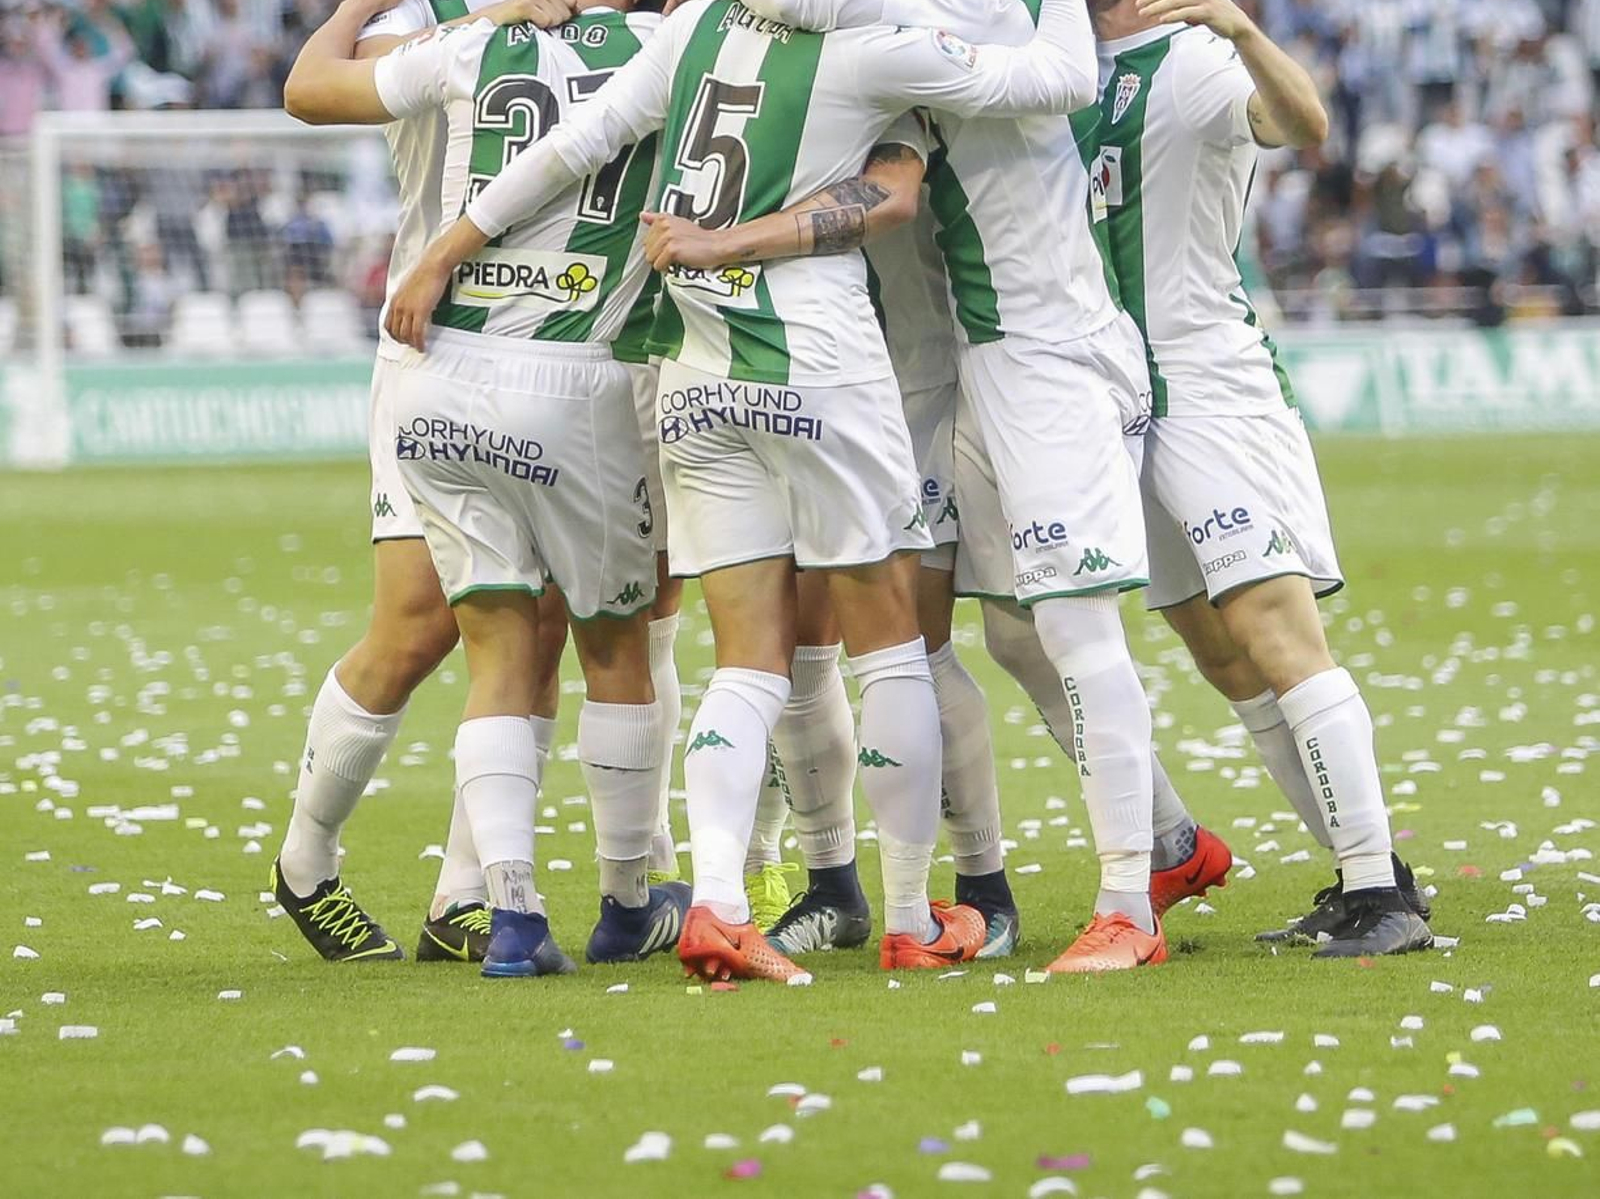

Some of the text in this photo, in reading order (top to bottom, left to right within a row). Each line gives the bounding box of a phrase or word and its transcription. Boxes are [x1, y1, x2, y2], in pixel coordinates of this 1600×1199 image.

[660, 73, 765, 232] 5
[660, 383, 802, 415] CORHYUND
[689, 407, 823, 441] HYUNDAI
[429, 441, 559, 487] HYUNDAI
[1064, 677, 1092, 777] CORDOBA
[1306, 737, 1341, 828] CORDOBA
